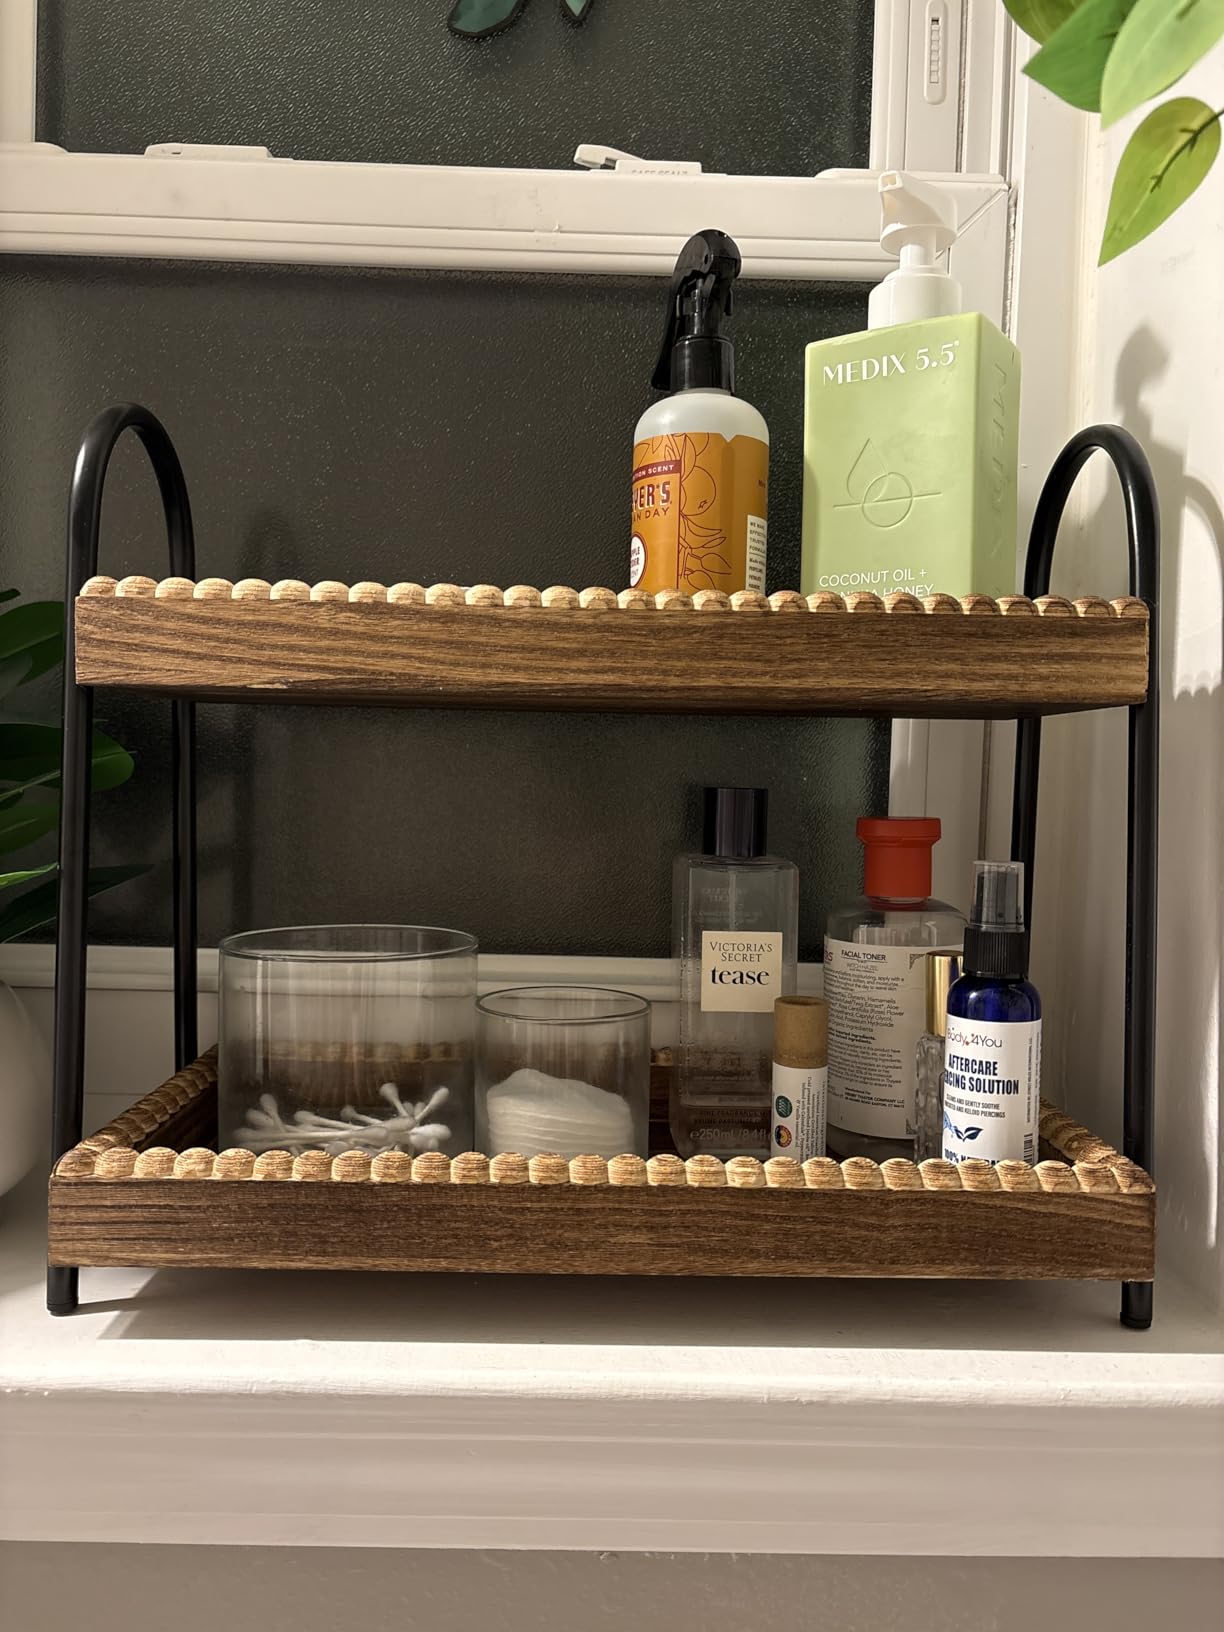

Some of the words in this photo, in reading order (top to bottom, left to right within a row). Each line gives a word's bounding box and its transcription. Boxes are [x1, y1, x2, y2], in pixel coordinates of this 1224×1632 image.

[823, 352, 906, 386] MEDIX
[647, 464, 674, 475] SCENT
[645, 507, 670, 519] DAY
[818, 570, 889, 588] COCONUT
[893, 568, 915, 583] OIL
[709, 941, 774, 953] VICTORIA'S
[720, 951, 763, 963] SECRET
[841, 949, 861, 958] FACIAL
[862, 952, 887, 961] TONER
[710, 965, 770, 986] tease
[948, 1053, 998, 1076] AFTERCARE
[968, 1076, 1020, 1095] SOLUTION
[965, 1099, 981, 1109] GENTLY
[981, 1102, 1001, 1111] SOOTHE
[980, 1110, 1006, 1119] PIERCINGS
